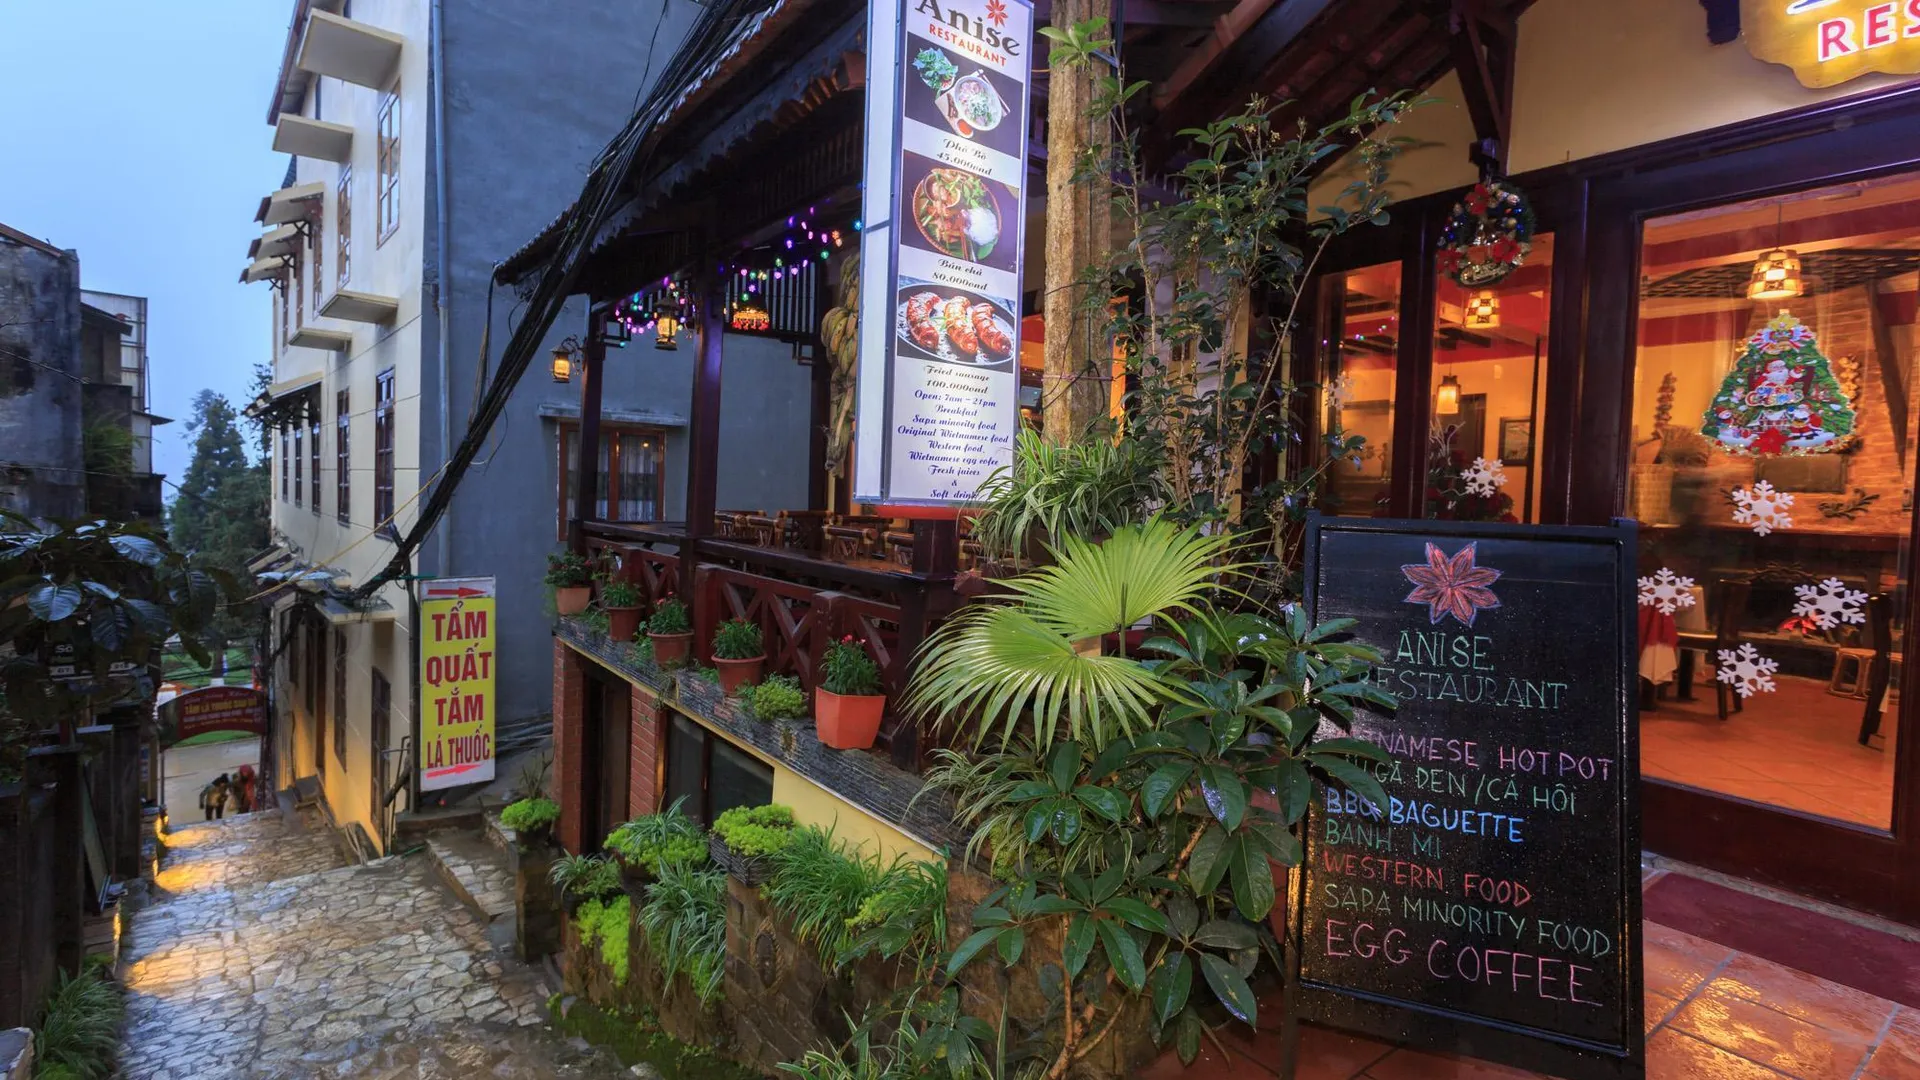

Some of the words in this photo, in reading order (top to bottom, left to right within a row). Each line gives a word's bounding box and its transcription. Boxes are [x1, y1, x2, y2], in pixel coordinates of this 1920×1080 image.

[915, 0, 1020, 56] Anise
[929, 23, 1007, 67] RESTAURANT
[924, 364, 953, 376] Fried
[914, 389, 941, 401] Open:
[944, 393, 963, 403] 7am
[972, 397, 997, 408] 21pm
[935, 404, 978, 417] Breakfast
[897, 425, 937, 437] Original
[990, 434, 1009, 443] food
[928, 440, 961, 449] Western
[939, 418, 976, 430] minority
[978, 422, 997, 431] food
[930, 489, 949, 500] Soft
[951, 479, 958, 487] &
[431, 600, 487, 642] TẨM
[426, 642, 492, 688] QUẤT
[1394, 629, 1495, 671] ANISE
[434, 686, 484, 727] TẮM
[426, 734, 444, 769] LÁ
[447, 723, 490, 767] THUỐC
[1389, 795, 1527, 844] BAGUETTE
[1323, 851, 1444, 891] WESTERN
[1464, 873, 1532, 907] FOOD
[1324, 883, 1391, 913] SAPA
[1403, 895, 1526, 940] MINORITY
[1538, 919, 1611, 958] FOOD
[1326, 918, 1413, 965] EGG
[1428, 939, 1604, 1008] COFFEE
